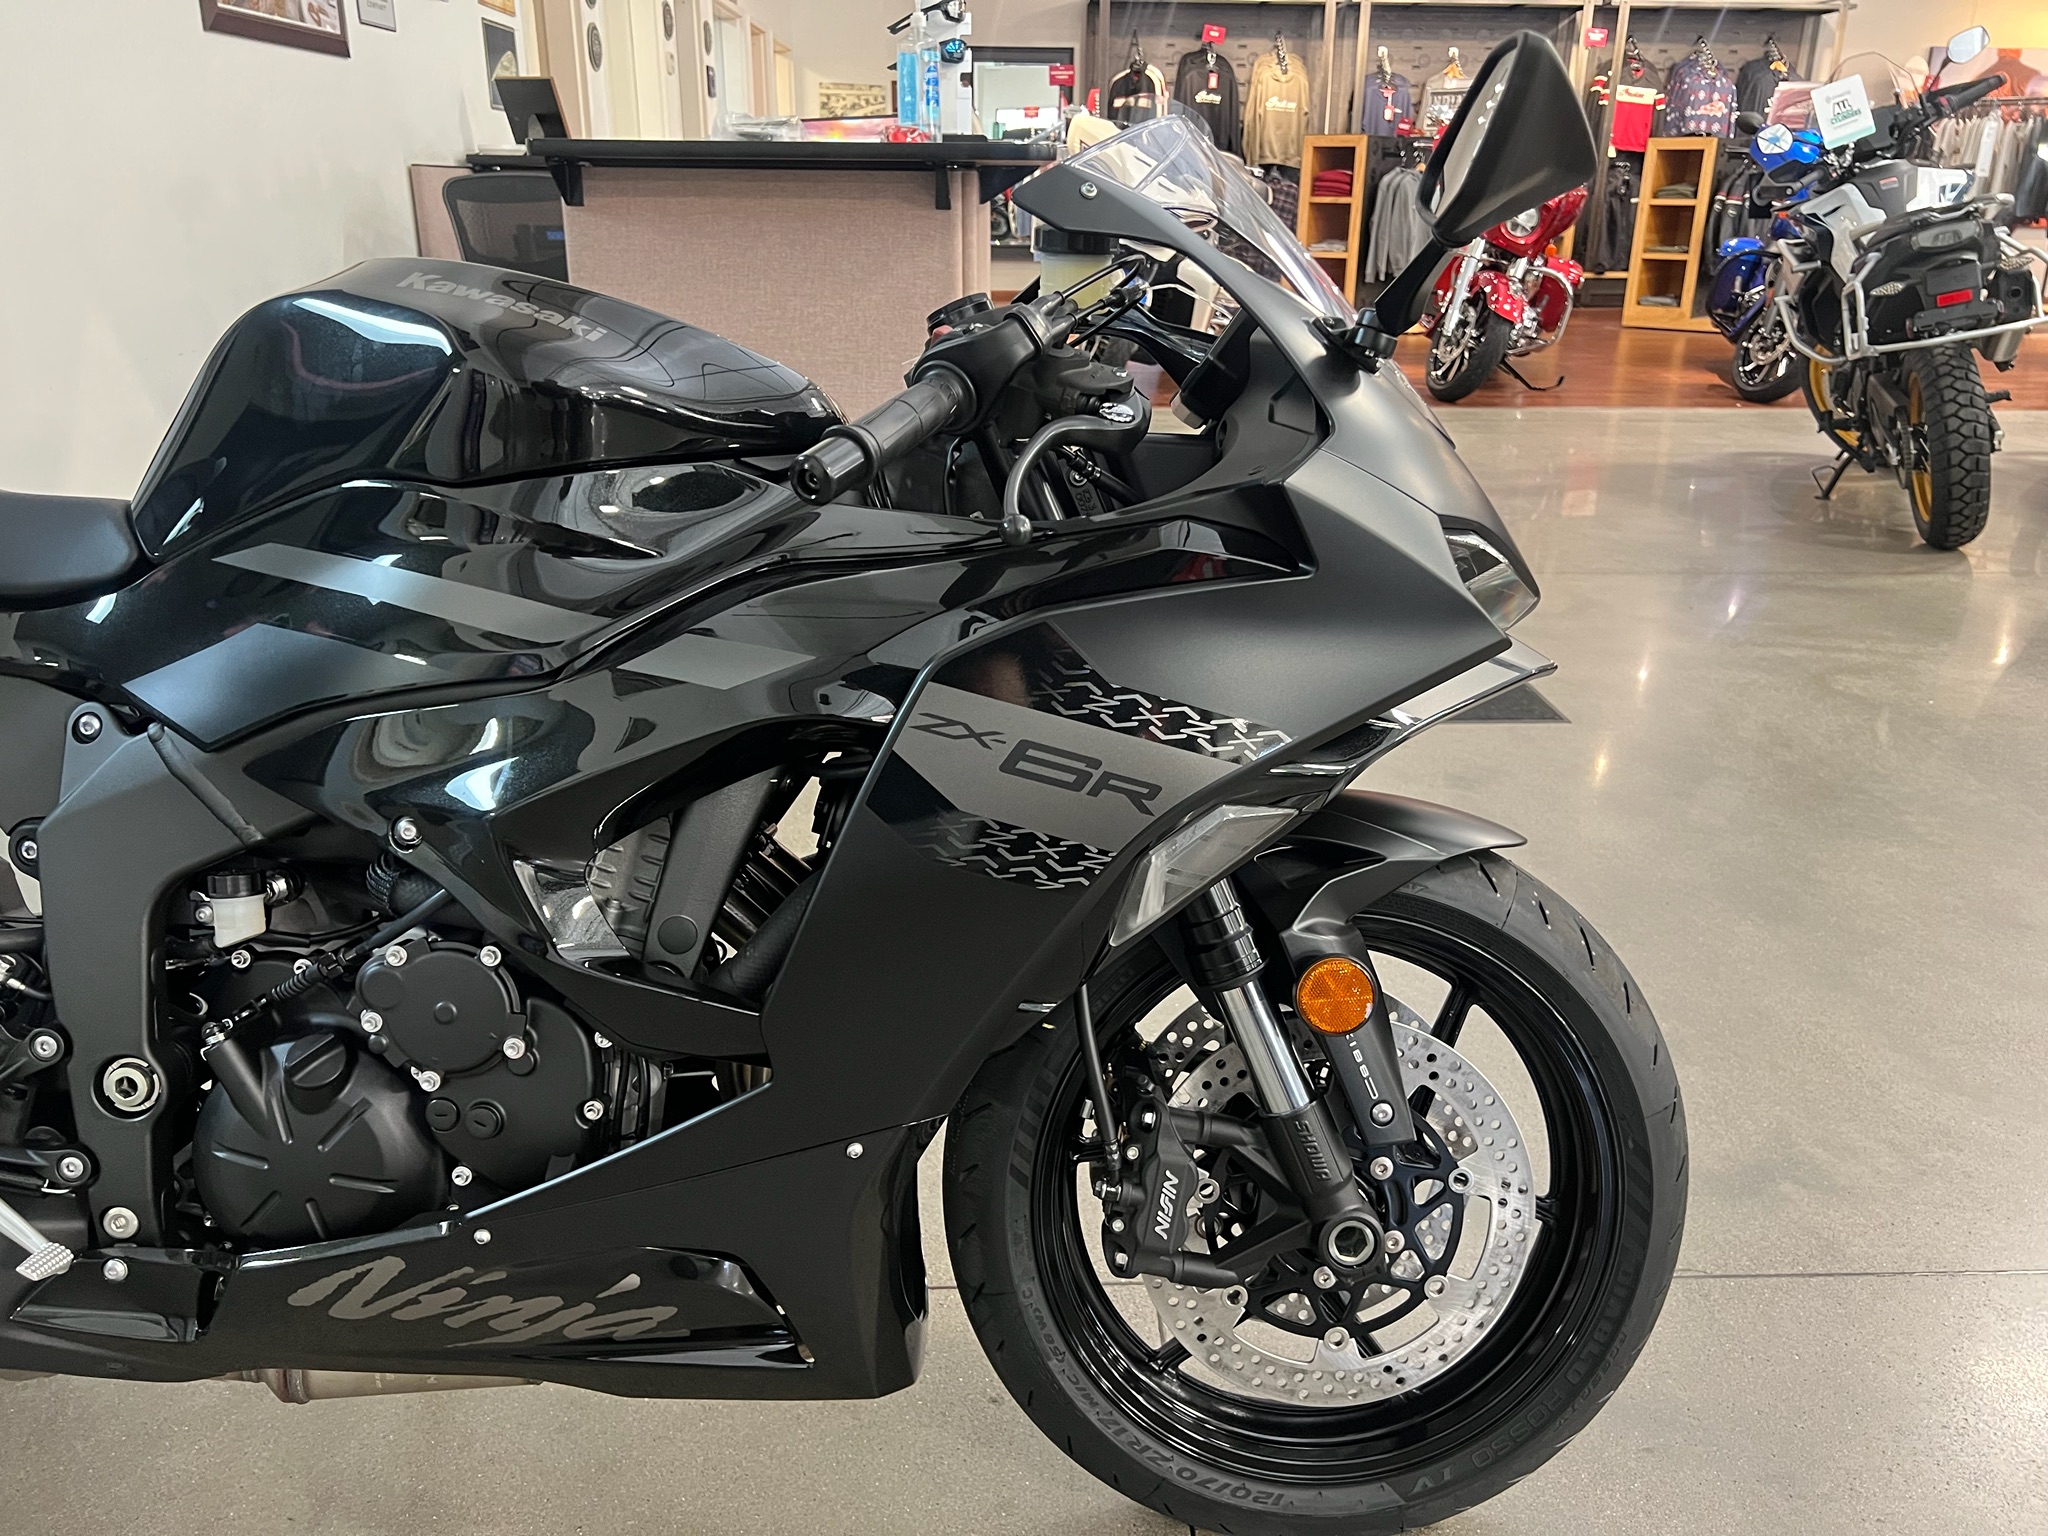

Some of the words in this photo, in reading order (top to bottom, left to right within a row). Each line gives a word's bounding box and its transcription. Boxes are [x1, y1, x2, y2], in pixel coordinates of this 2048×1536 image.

[396, 272, 608, 342] Kawasaki
[1295, 1120, 1332, 1181] SHOWA
[1154, 1169, 1179, 1240] NISSIN
[287, 1255, 690, 1348] Ninja
